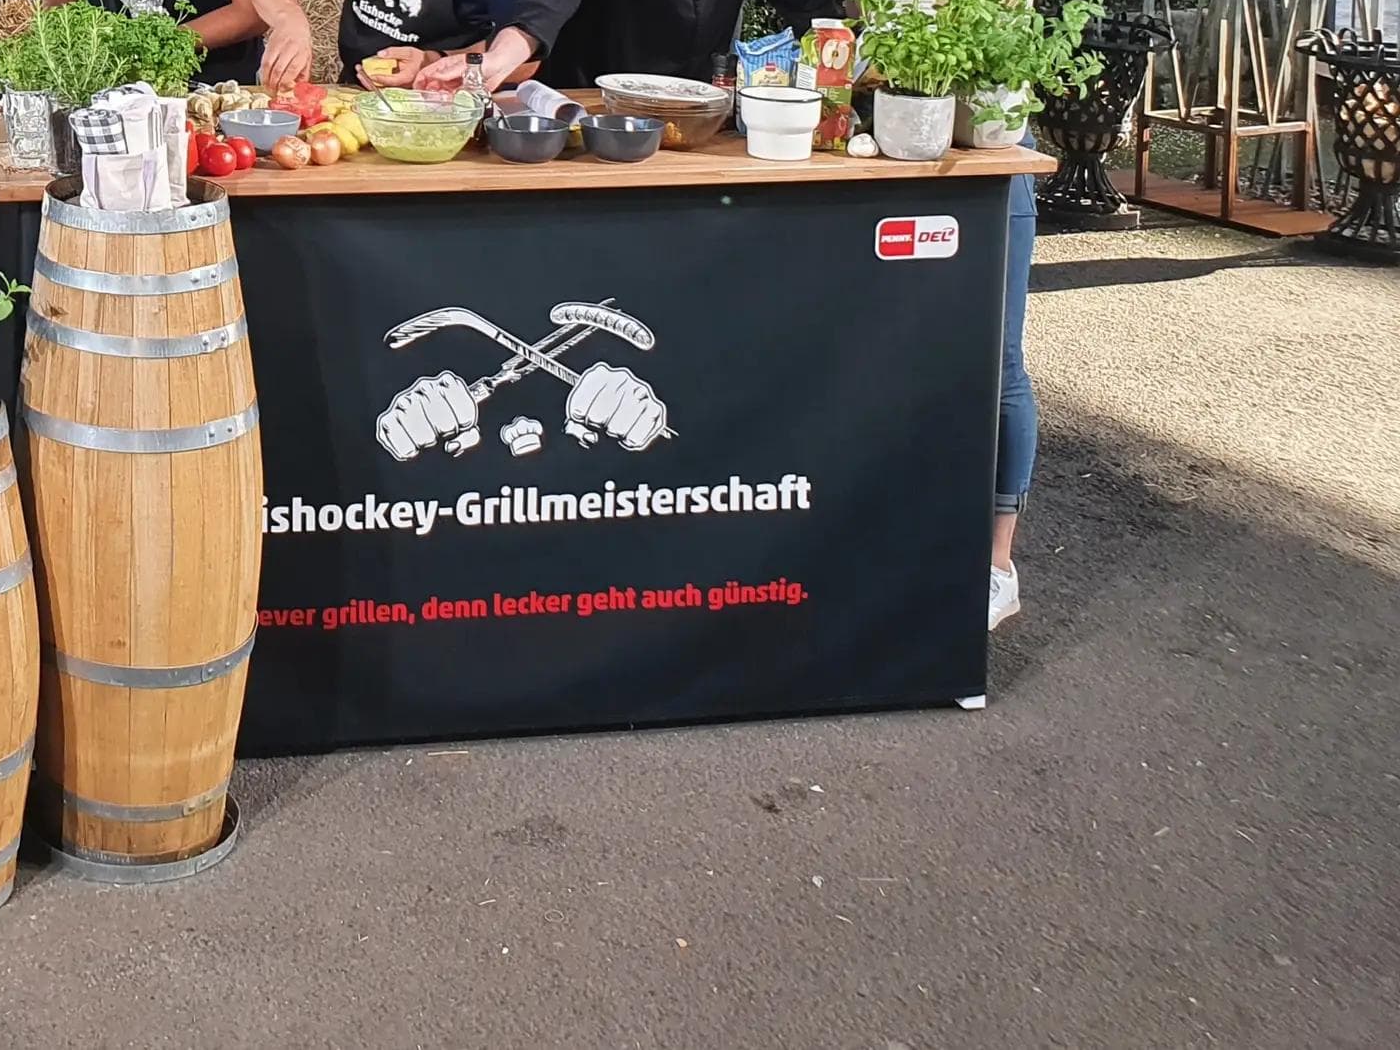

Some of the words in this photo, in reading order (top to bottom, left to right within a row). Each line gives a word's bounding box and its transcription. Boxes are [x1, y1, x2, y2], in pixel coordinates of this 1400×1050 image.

[918, 227, 955, 243] DEL
[261, 474, 811, 536] ishockey-Grillmeisterschaft
[259, 607, 316, 628] ever
[322, 598, 416, 630] grillen,
[421, 595, 488, 621] denn
[493, 591, 573, 617] lecker
[576, 586, 637, 617] geht
[641, 583, 703, 609] auch
[707, 577, 809, 611] günstig.
